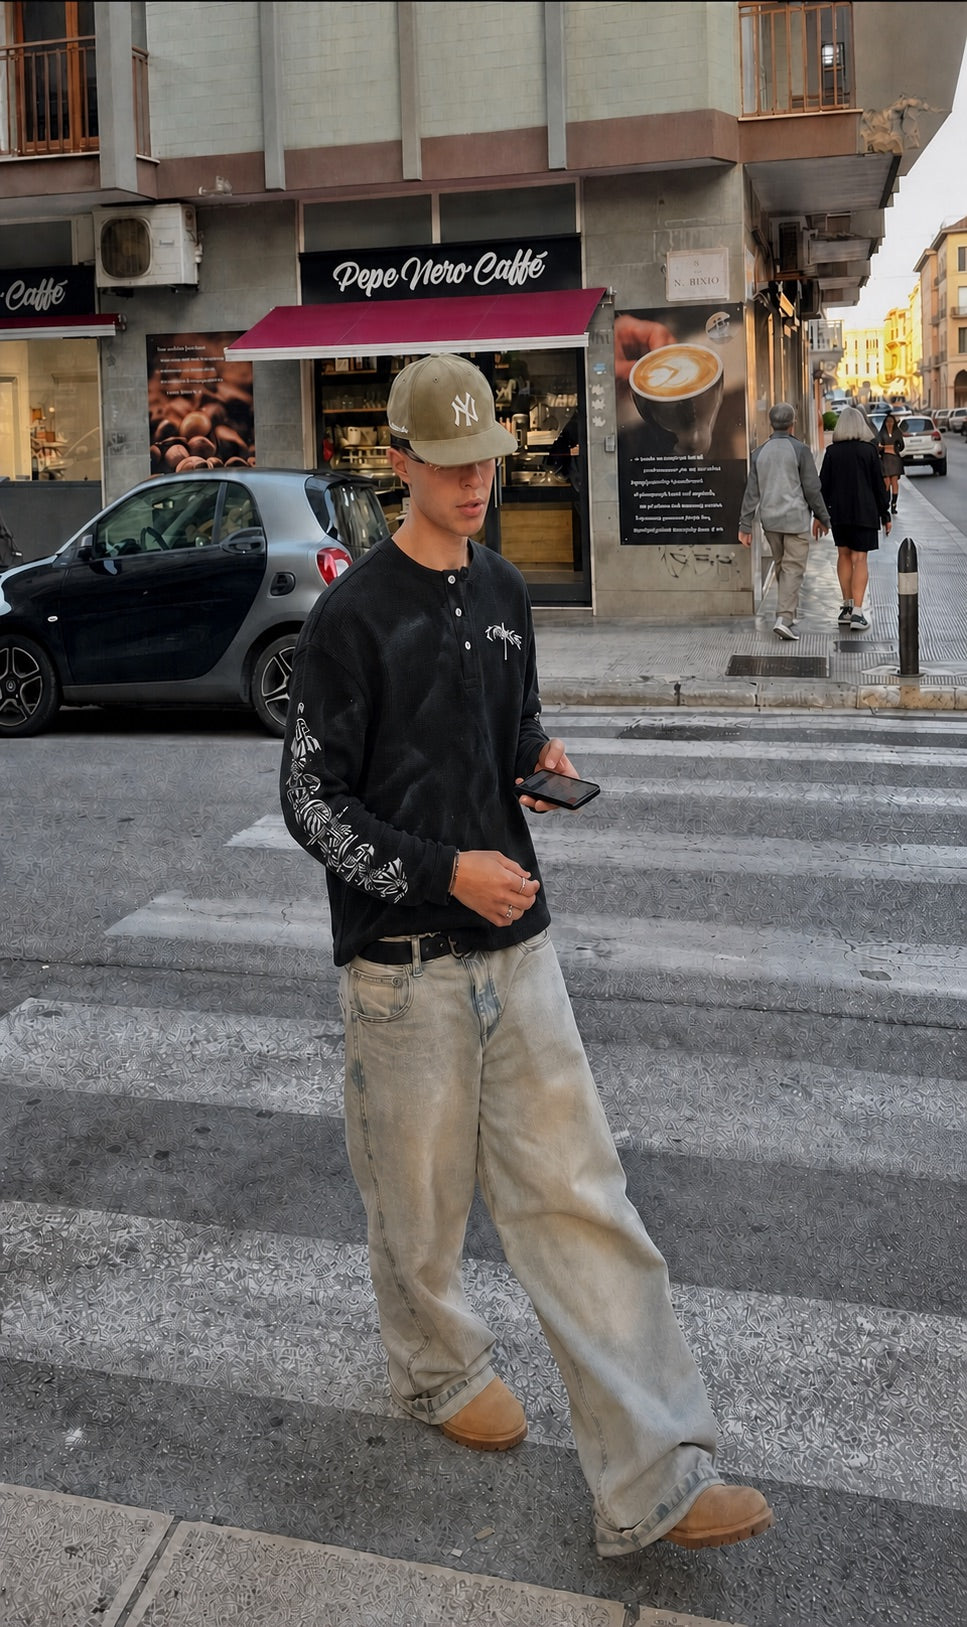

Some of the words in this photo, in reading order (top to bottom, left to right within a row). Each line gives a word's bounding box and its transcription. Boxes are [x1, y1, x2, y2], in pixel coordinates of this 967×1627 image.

[333, 261, 399, 297] Pepe
[401, 256, 472, 291] Nero
[473, 248, 549, 286] Caffé
[689, 277, 720, 287] BIXIO
[5, 277, 68, 311] Caffé
[451, 392, 479, 427] NY
